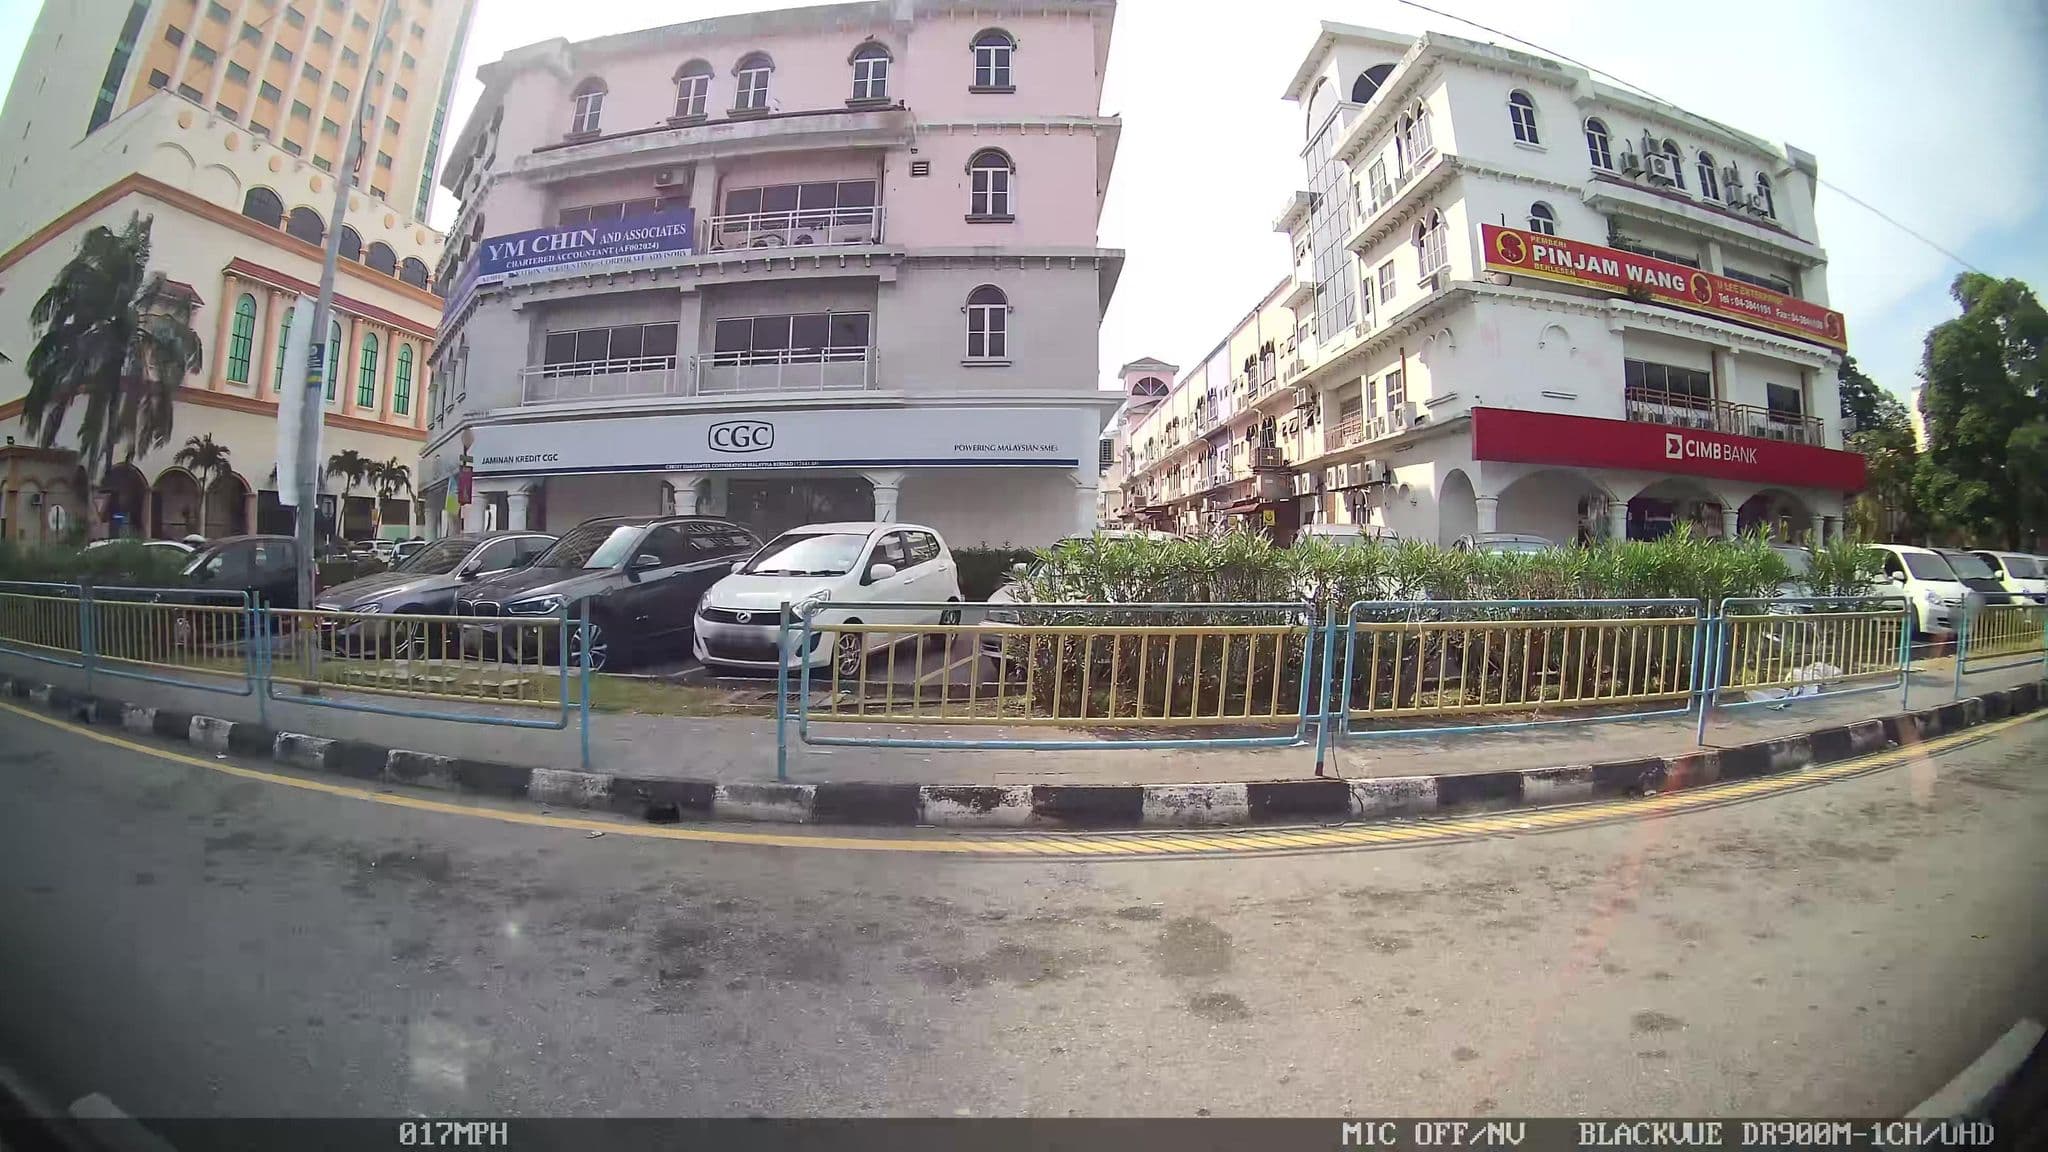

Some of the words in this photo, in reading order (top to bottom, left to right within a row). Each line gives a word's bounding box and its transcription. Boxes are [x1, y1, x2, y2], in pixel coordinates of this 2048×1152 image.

[488, 240, 525, 261] YM
[532, 227, 598, 253] CHIN
[600, 232, 621, 245] AND
[622, 223, 687, 241] ASSOCIATES
[506, 255, 555, 269] CHARTERED
[556, 246, 614, 261] ACCOUNTANT
[1532, 244, 1620, 278] PINJAM
[1625, 263, 1686, 293] WANG
[713, 425, 769, 448] CGC
[954, 444, 996, 452] POWERING
[998, 444, 1039, 452] MALAYSIAN
[481, 455, 514, 465] JAMINAN
[515, 454, 542, 463] KREDIT
[542, 453, 559, 462] CGC
[1686, 439, 1722, 460] CIMB
[1723, 444, 1758, 464] BANK
